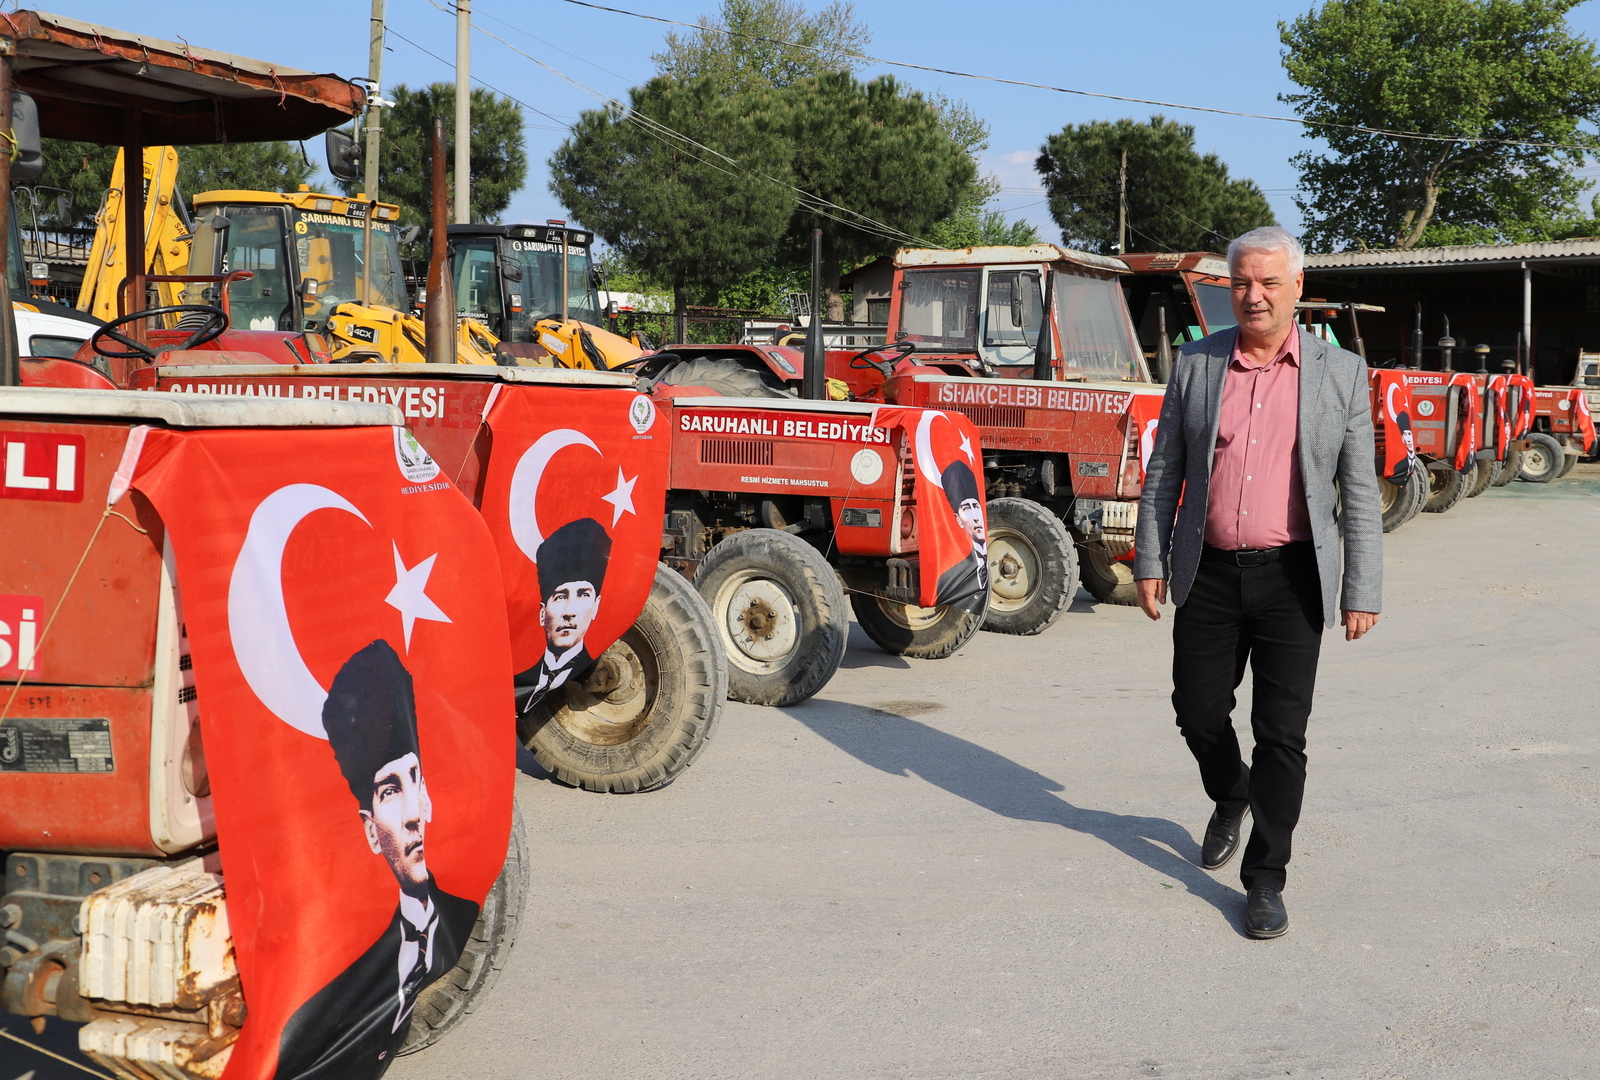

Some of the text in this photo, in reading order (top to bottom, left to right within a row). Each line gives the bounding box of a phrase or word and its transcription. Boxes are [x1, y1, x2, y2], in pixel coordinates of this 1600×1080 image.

[353, 328, 372, 338] 4CX
[681, 415, 778, 435] SARUHANLI
[790, 478, 829, 488] MAHSUSTUR
